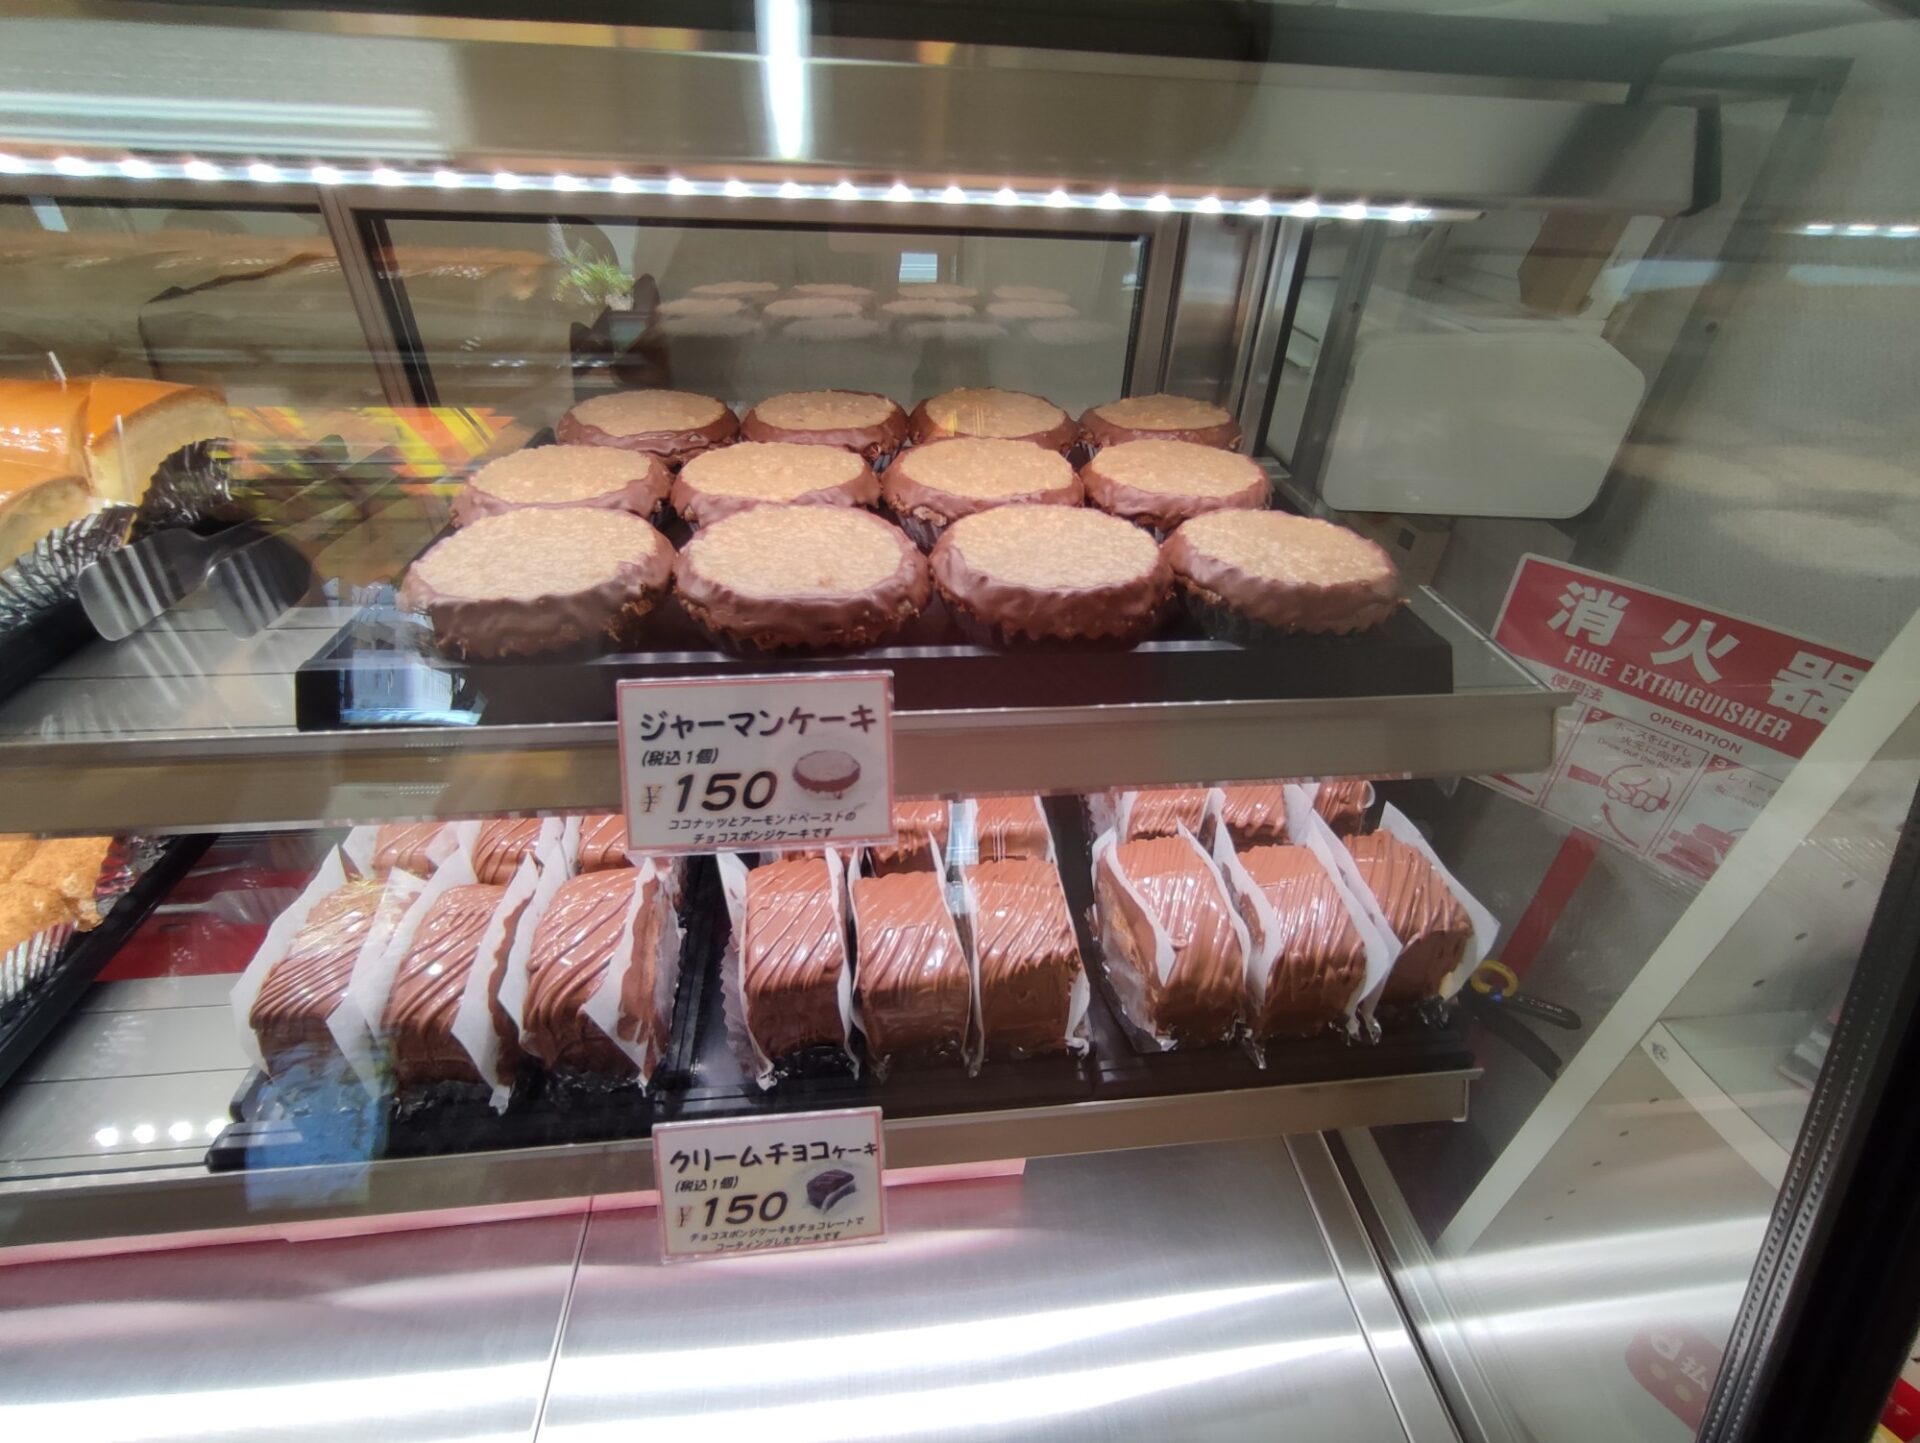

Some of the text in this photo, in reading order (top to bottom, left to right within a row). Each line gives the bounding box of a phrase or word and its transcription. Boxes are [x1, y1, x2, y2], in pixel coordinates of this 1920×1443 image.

[1547, 580, 1869, 729] 消火器
[1565, 645, 1793, 742] FIRE EXTINGUISHER
[641, 704, 877, 742] ジャーマンケーキ
[1649, 712, 1744, 755] OPERATION
[693, 827, 834, 845] チョコスポンジケーキです
[669, 1141, 878, 1174] クリームチョコケーキ
